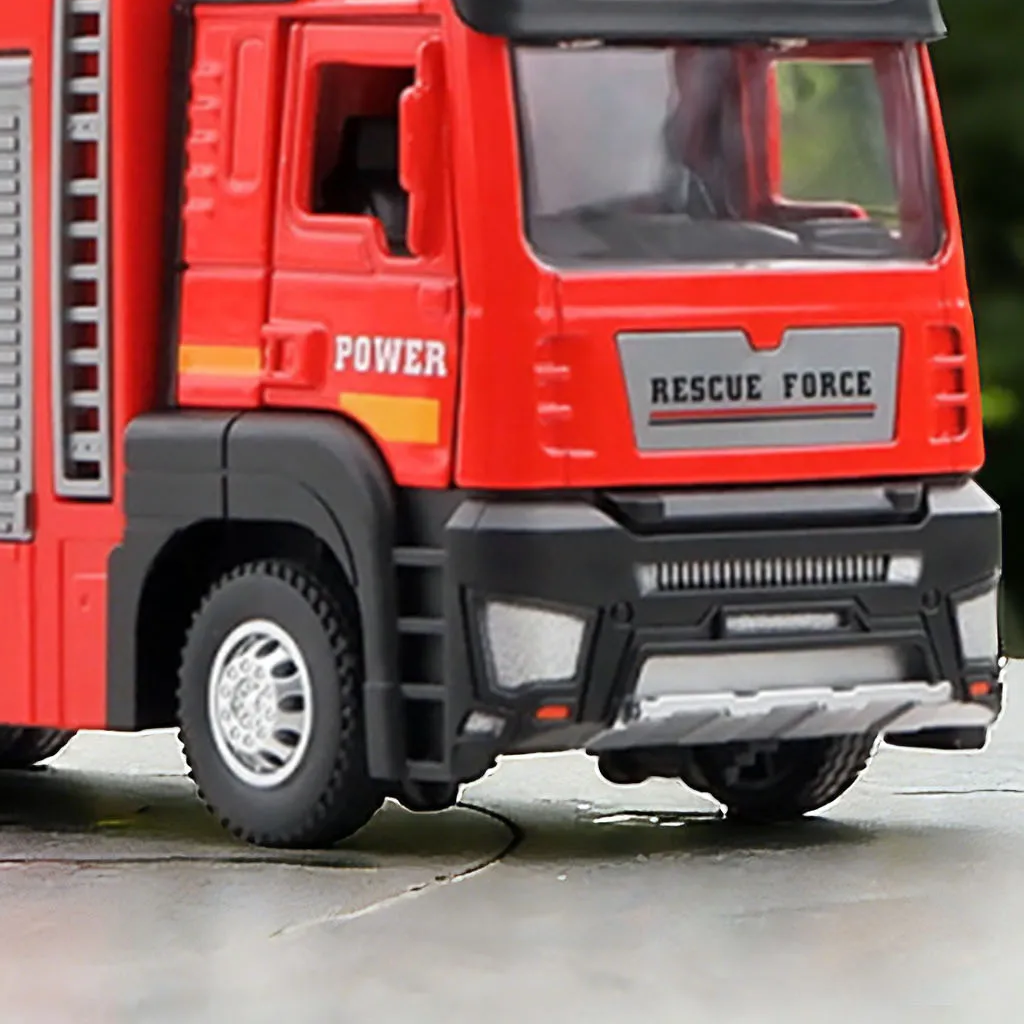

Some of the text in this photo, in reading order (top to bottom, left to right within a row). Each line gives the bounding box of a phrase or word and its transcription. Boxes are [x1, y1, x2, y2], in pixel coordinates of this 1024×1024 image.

[333, 334, 447, 378] POWER
[650, 369, 872, 404] RESCUE FORCE
